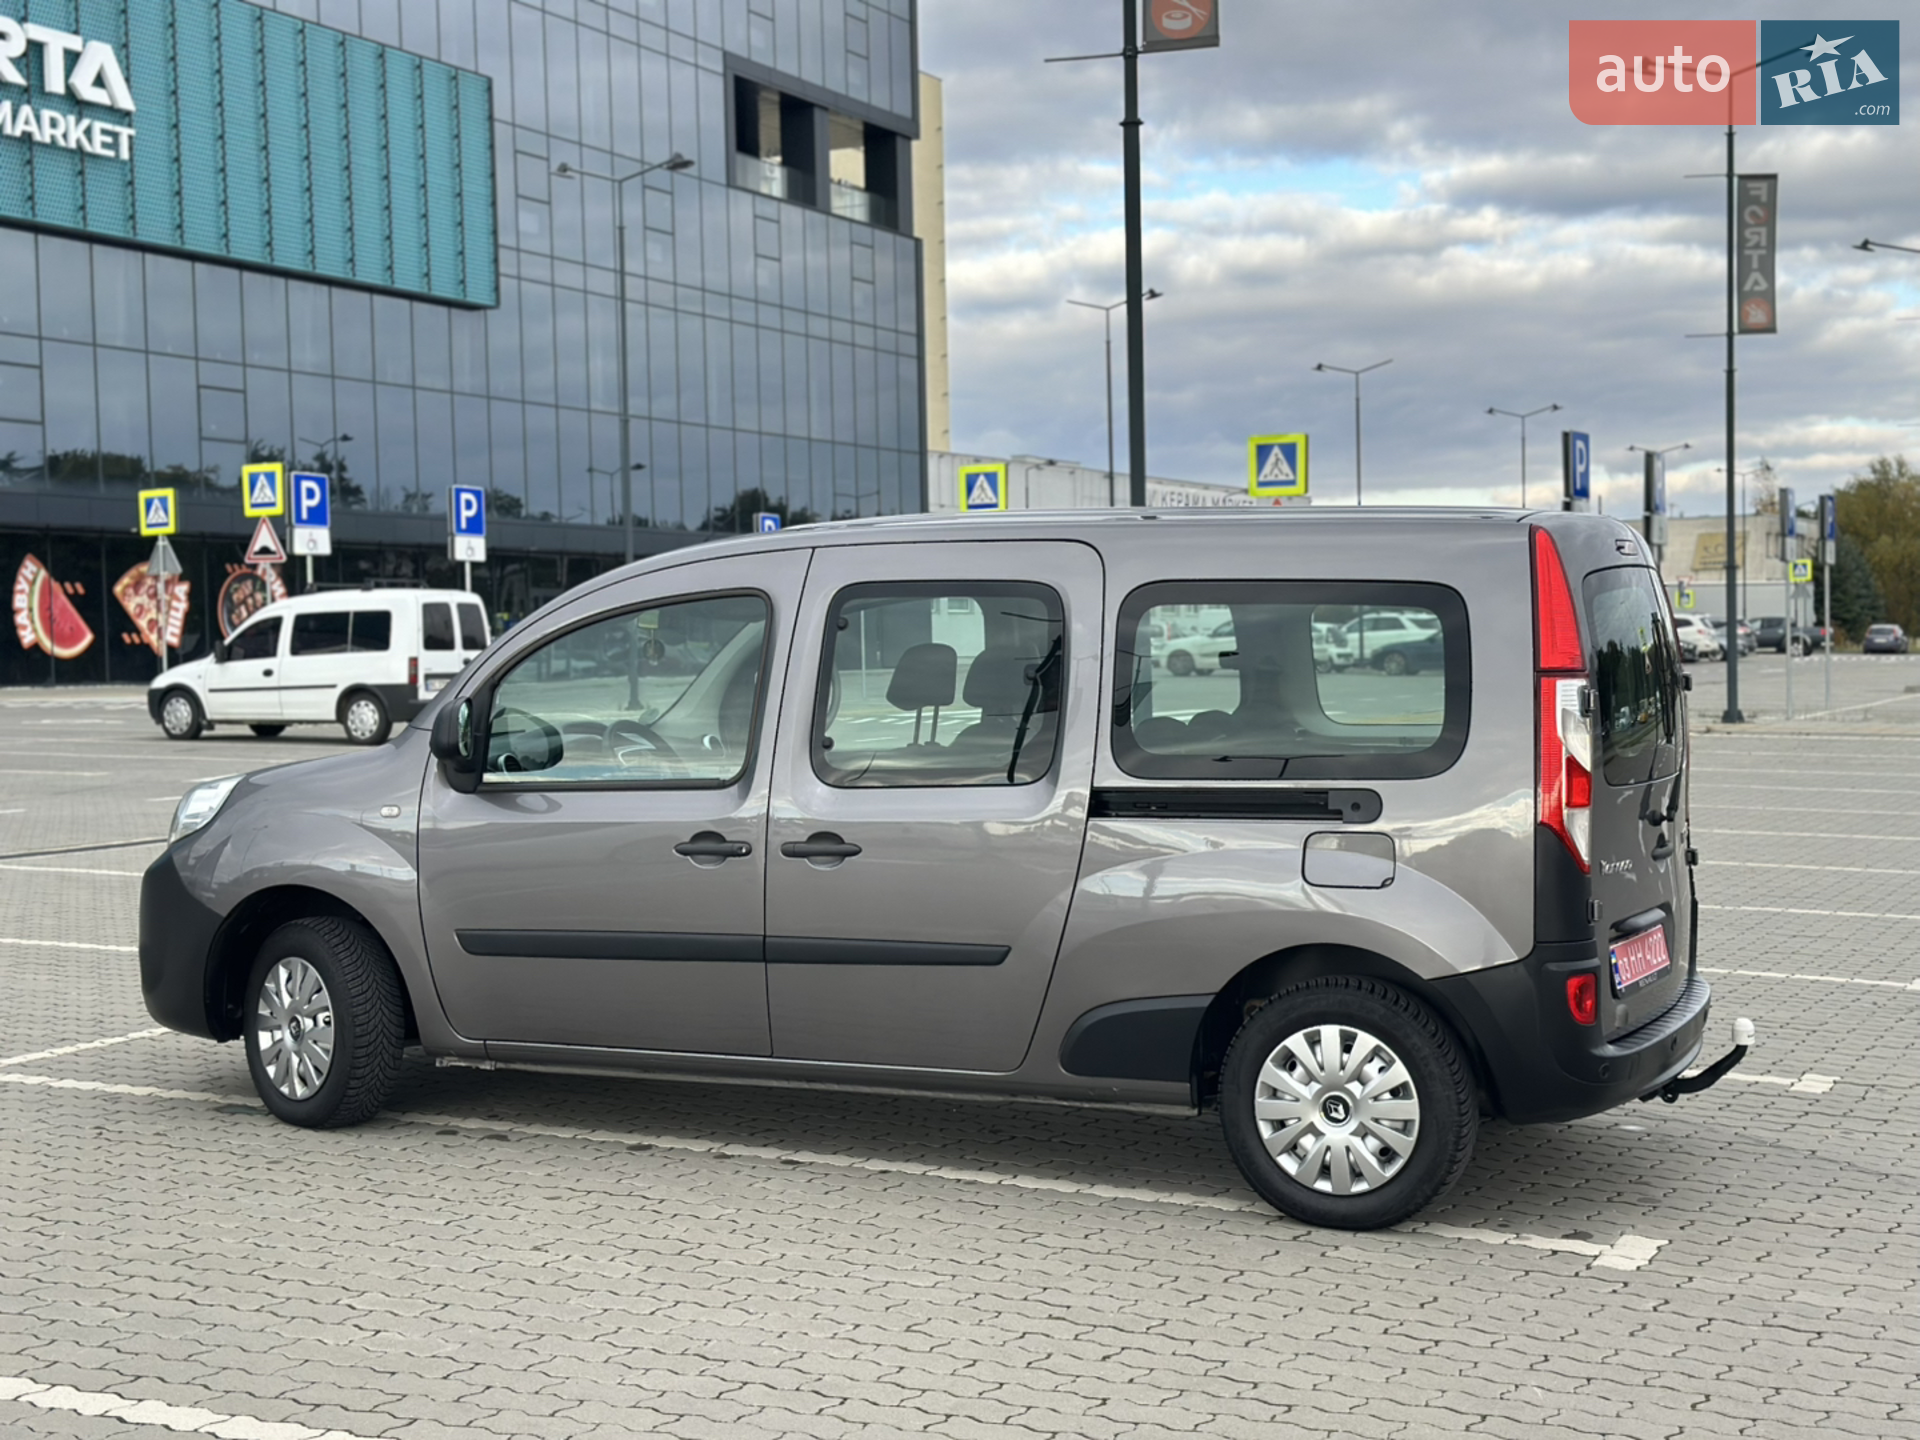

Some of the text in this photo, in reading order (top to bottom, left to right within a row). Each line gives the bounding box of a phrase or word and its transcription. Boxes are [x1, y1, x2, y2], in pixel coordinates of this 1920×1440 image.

[0, 15, 136, 113] RTA
[1575, 439, 1588, 490] P
[300, 479, 321, 521] P
[459, 491, 478, 530] P
[13, 559, 38, 644] КАВУН
[166, 583, 190, 645] ПІЦА
